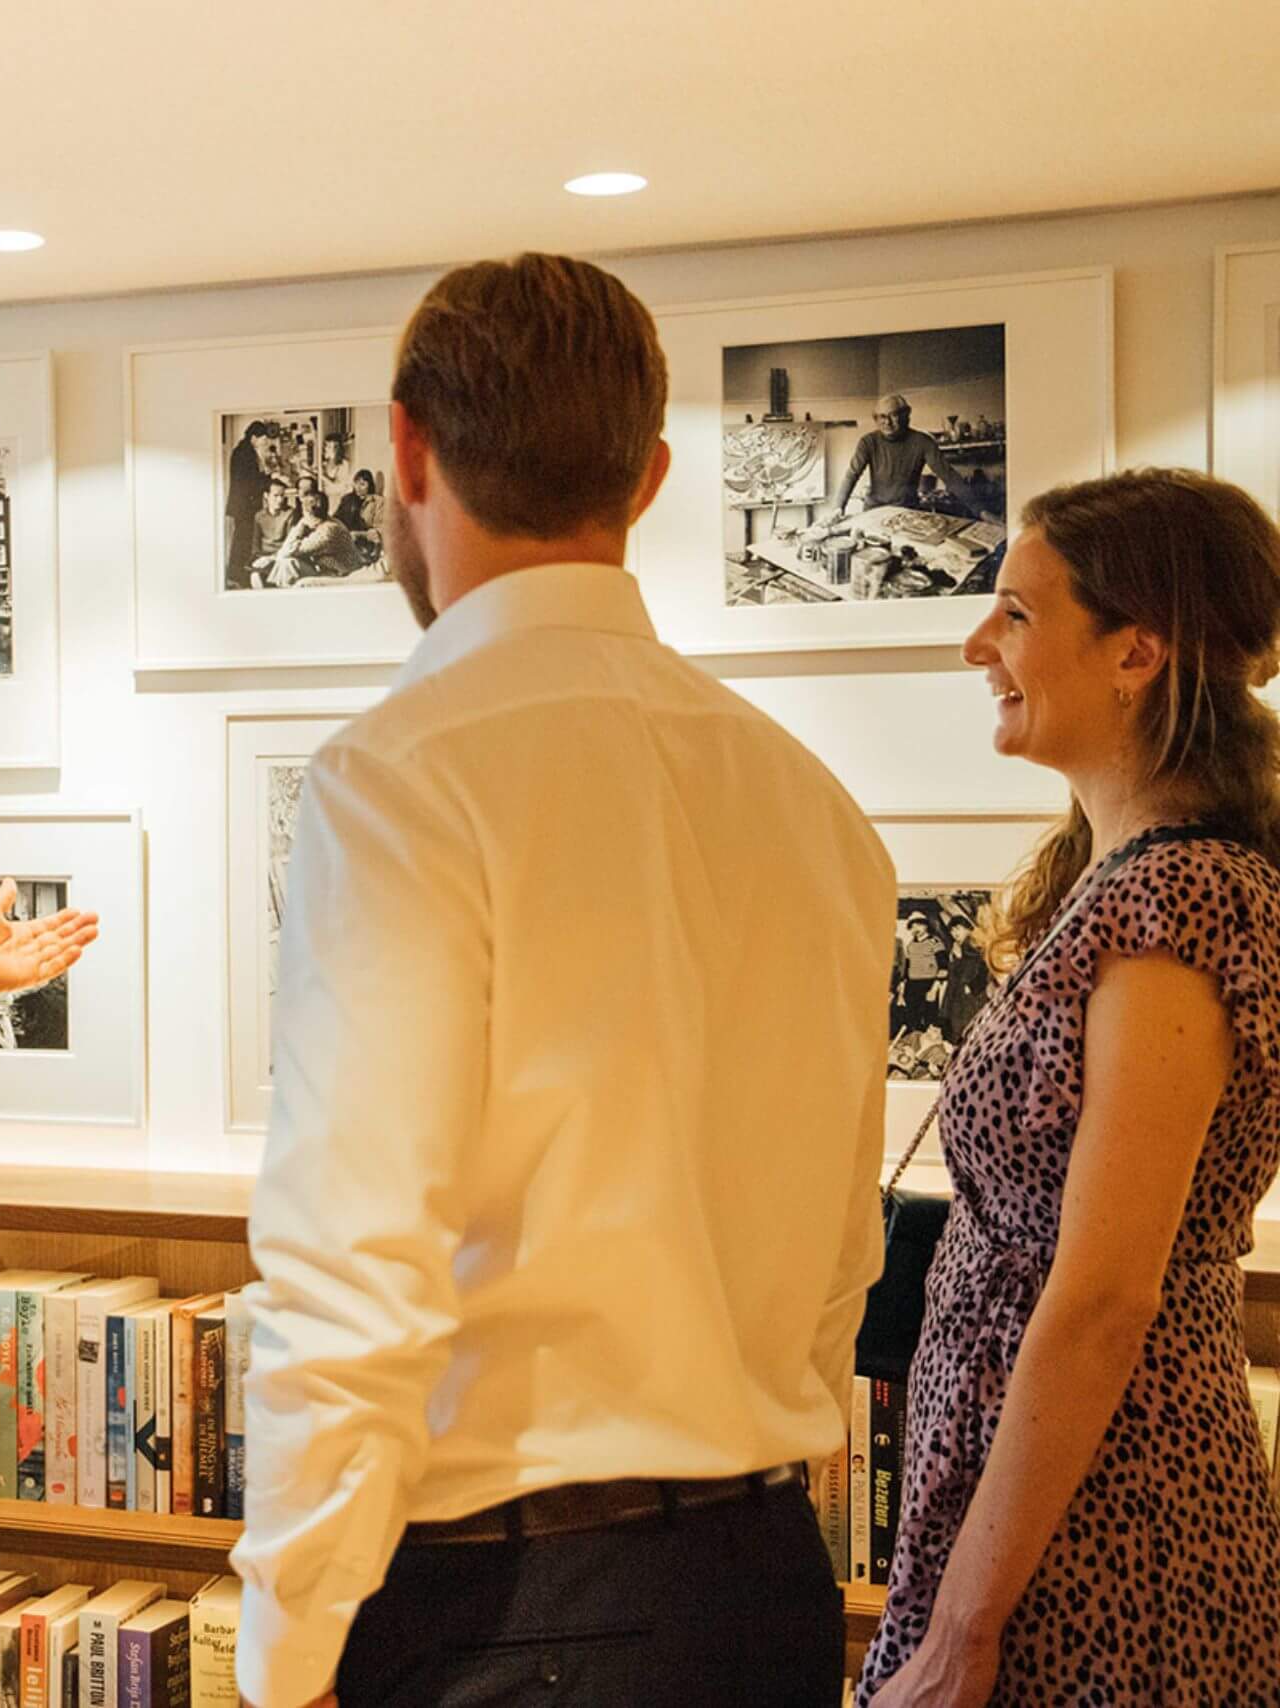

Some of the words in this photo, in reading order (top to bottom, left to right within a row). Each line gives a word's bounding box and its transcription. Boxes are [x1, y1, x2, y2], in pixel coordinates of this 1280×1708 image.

[20, 1296, 32, 1335] Boyle
[2, 1333, 11, 1372] BOYLE
[198, 1437, 208, 1477] HEMEL
[207, 1433, 216, 1463] RING
[829, 1463, 839, 1499] TUSSEN
[875, 1469, 892, 1528] Bezeten
[90, 1632, 105, 1657] PAUL
[126, 1642, 143, 1673] Stefan
[90, 1661, 105, 1705] BRITTON
[126, 1675, 142, 1699] Brijs
